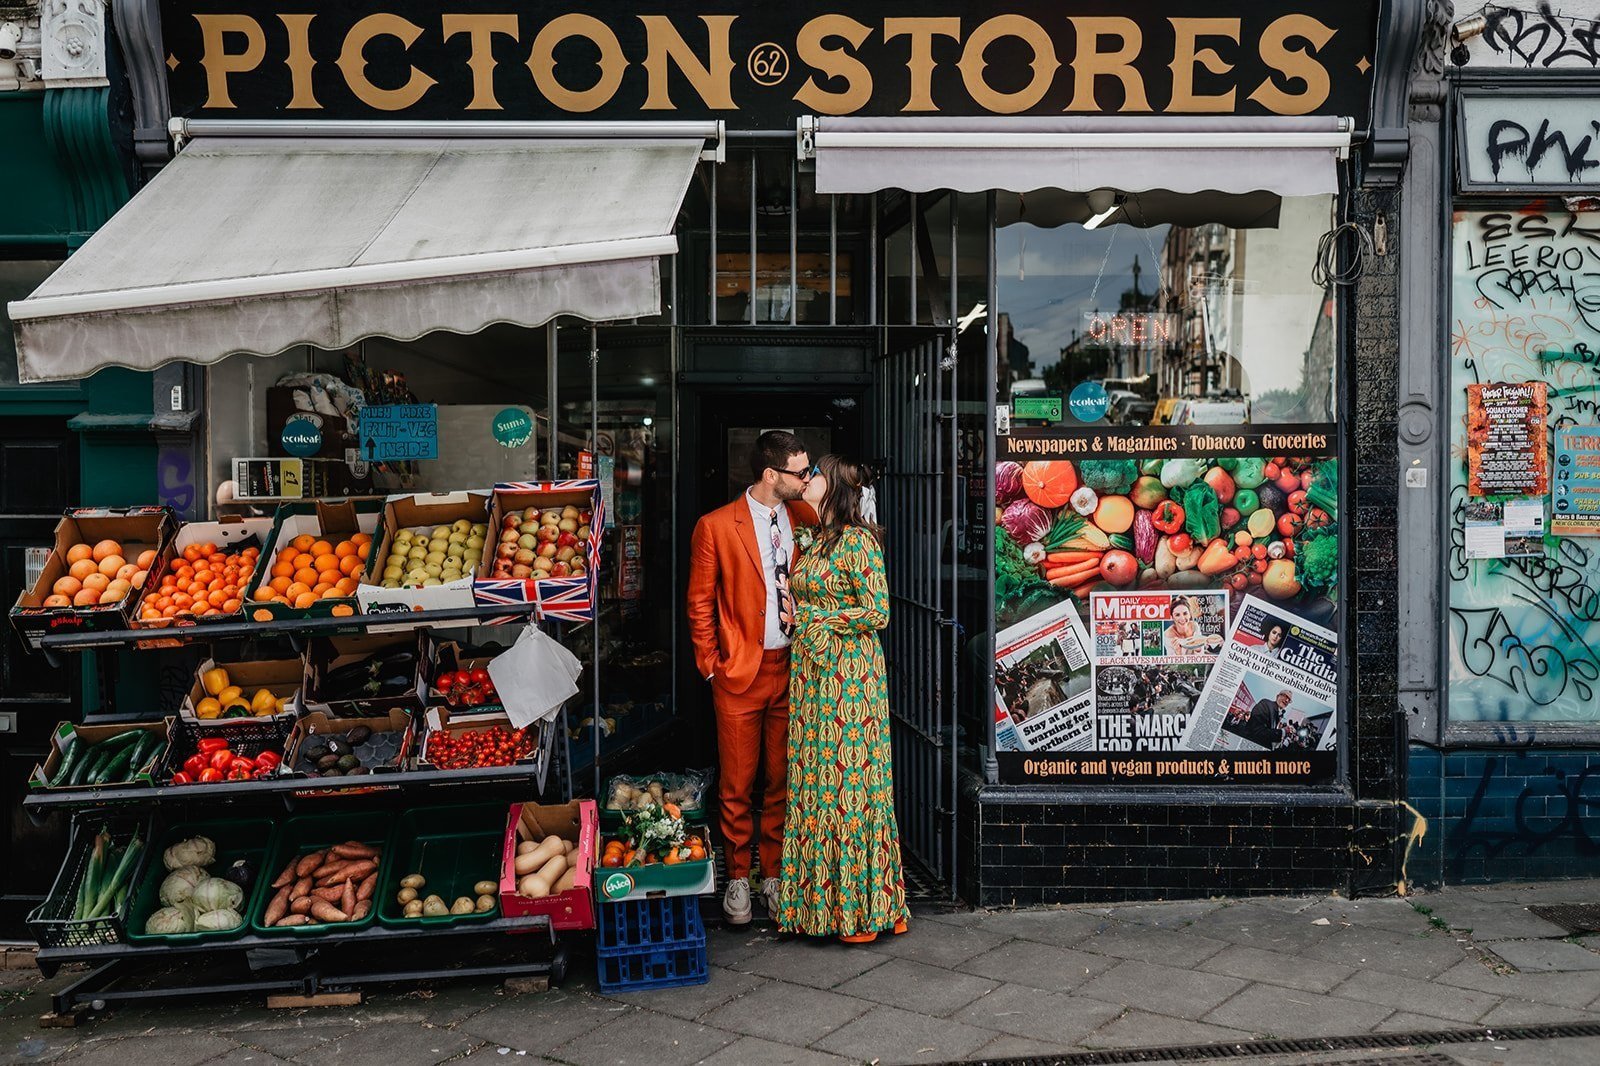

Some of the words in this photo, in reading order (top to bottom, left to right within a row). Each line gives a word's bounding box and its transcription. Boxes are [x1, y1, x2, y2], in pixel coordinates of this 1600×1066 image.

[192, 13, 739, 111] PICTON
[792, 13, 1339, 114] STORES
[1089, 315, 1169, 339] OPEN
[1069, 396, 1109, 407] ecoleaf
[400, 406, 431, 419] MORE
[497, 418, 526, 432] Suma
[282, 434, 321, 444] ecoleaf
[1007, 437, 1088, 455] Newspapers
[1091, 436, 1104, 452] &
[1107, 435, 1178, 454] Magazines
[1189, 434, 1246, 451] Tobacco
[1262, 432, 1327, 449] Groceries
[380, 441, 431, 459] INSIDE
[284, 470, 300, 487] £1
[1096, 597, 1170, 619] Mirror
[1120, 597, 1141, 605] DAILY
[1096, 635, 1116, 645] 80%
[1099, 657, 1126, 665] BLACK
[1127, 656, 1151, 664] LIVES
[1152, 656, 1184, 664] MATTER
[1299, 643, 1325, 664] The
[1230, 642, 1259, 660] Corbyn
[1259, 656, 1281, 670] urges
[1281, 666, 1305, 682] voters
[1305, 676, 1314, 686] to
[1228, 651, 1251, 667] 'shock
[1251, 660, 1261, 671] to
[1260, 665, 1275, 678] the
[1274, 672, 1332, 702] establishment'
[1023, 719, 1046, 737] Stay
[1048, 713, 1061, 725] at
[1060, 699, 1091, 719] home
[1097, 714, 1133, 738] THE
[1135, 714, 1192, 738] MARC
[1028, 718, 1073, 746] warning
[1073, 711, 1090, 725] for
[1023, 758, 1078, 777] Organic
[1080, 758, 1107, 775] and
[1110, 760, 1152, 777] vegan
[1156, 758, 1215, 777] products
[1218, 758, 1230, 775] &
[1233, 758, 1272, 775] much
[1275, 760, 1311, 775] more
